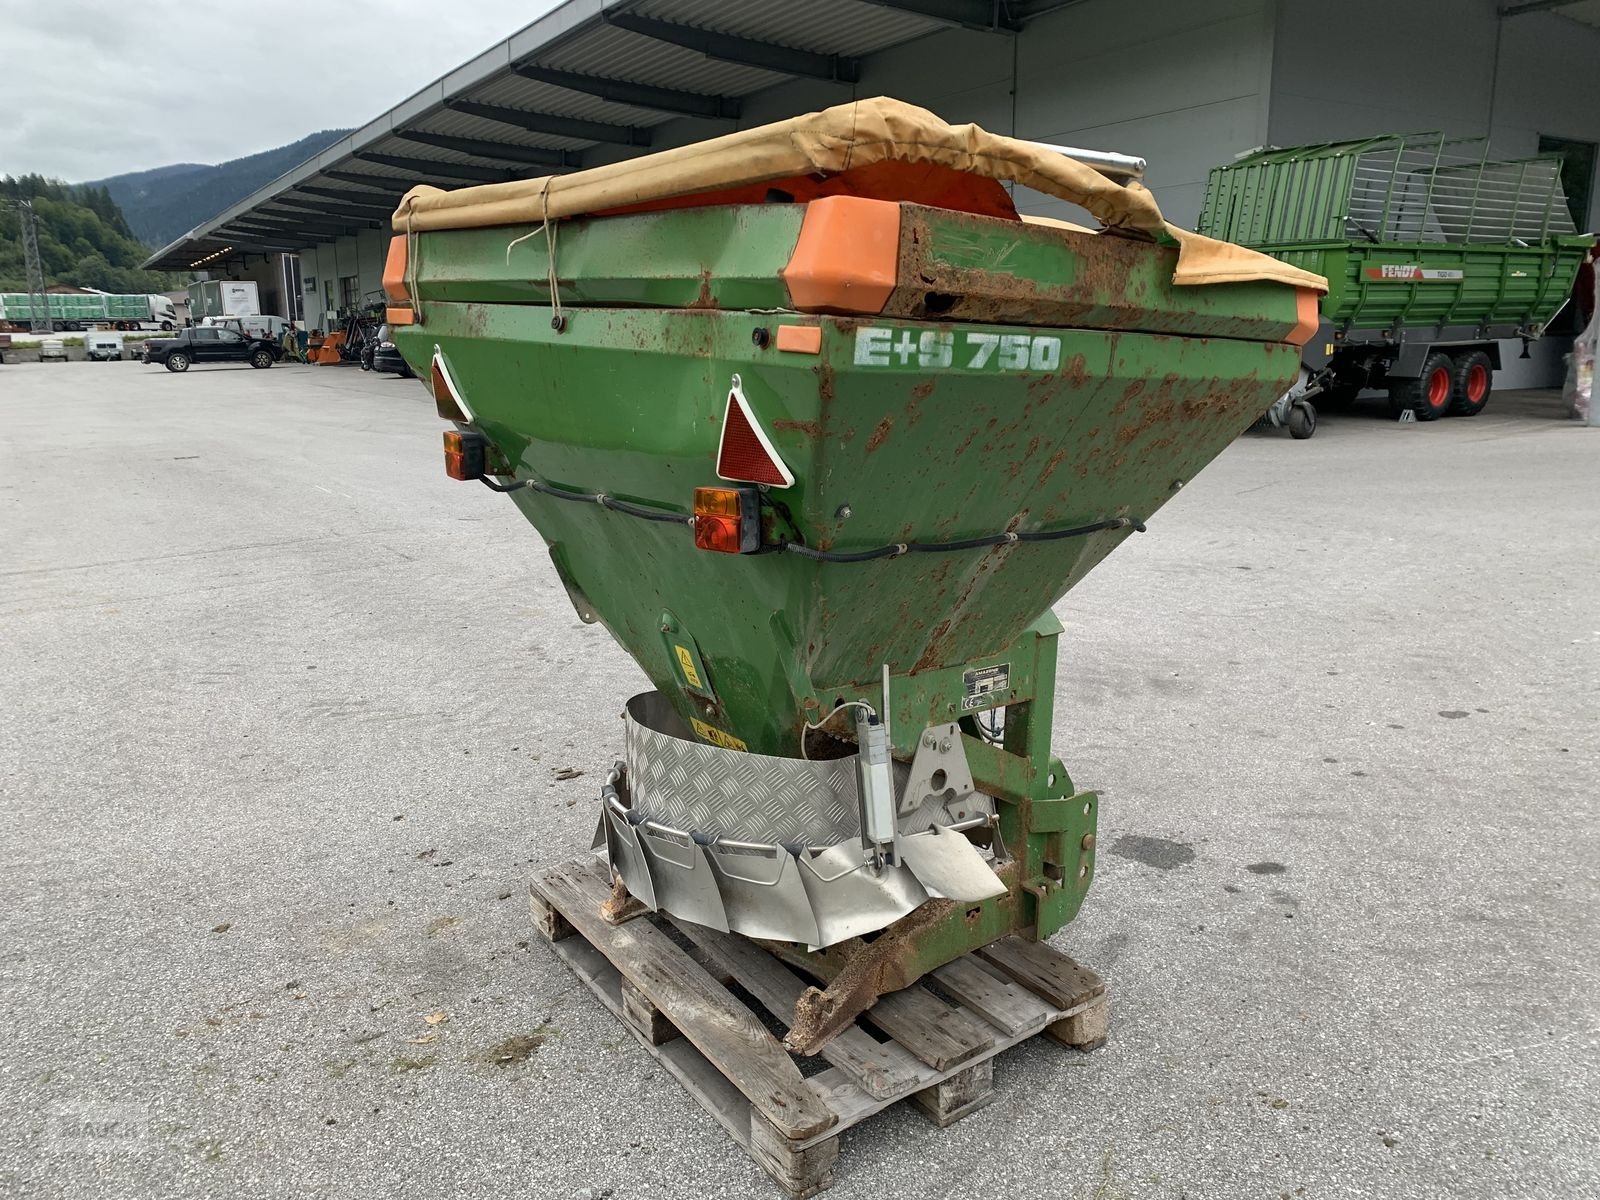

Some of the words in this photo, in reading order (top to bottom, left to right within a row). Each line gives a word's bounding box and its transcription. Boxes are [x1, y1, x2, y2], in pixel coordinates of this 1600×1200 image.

[1381, 264, 1418, 278] FENDT
[854, 326, 954, 367] E+S
[966, 332, 1062, 371] 750
